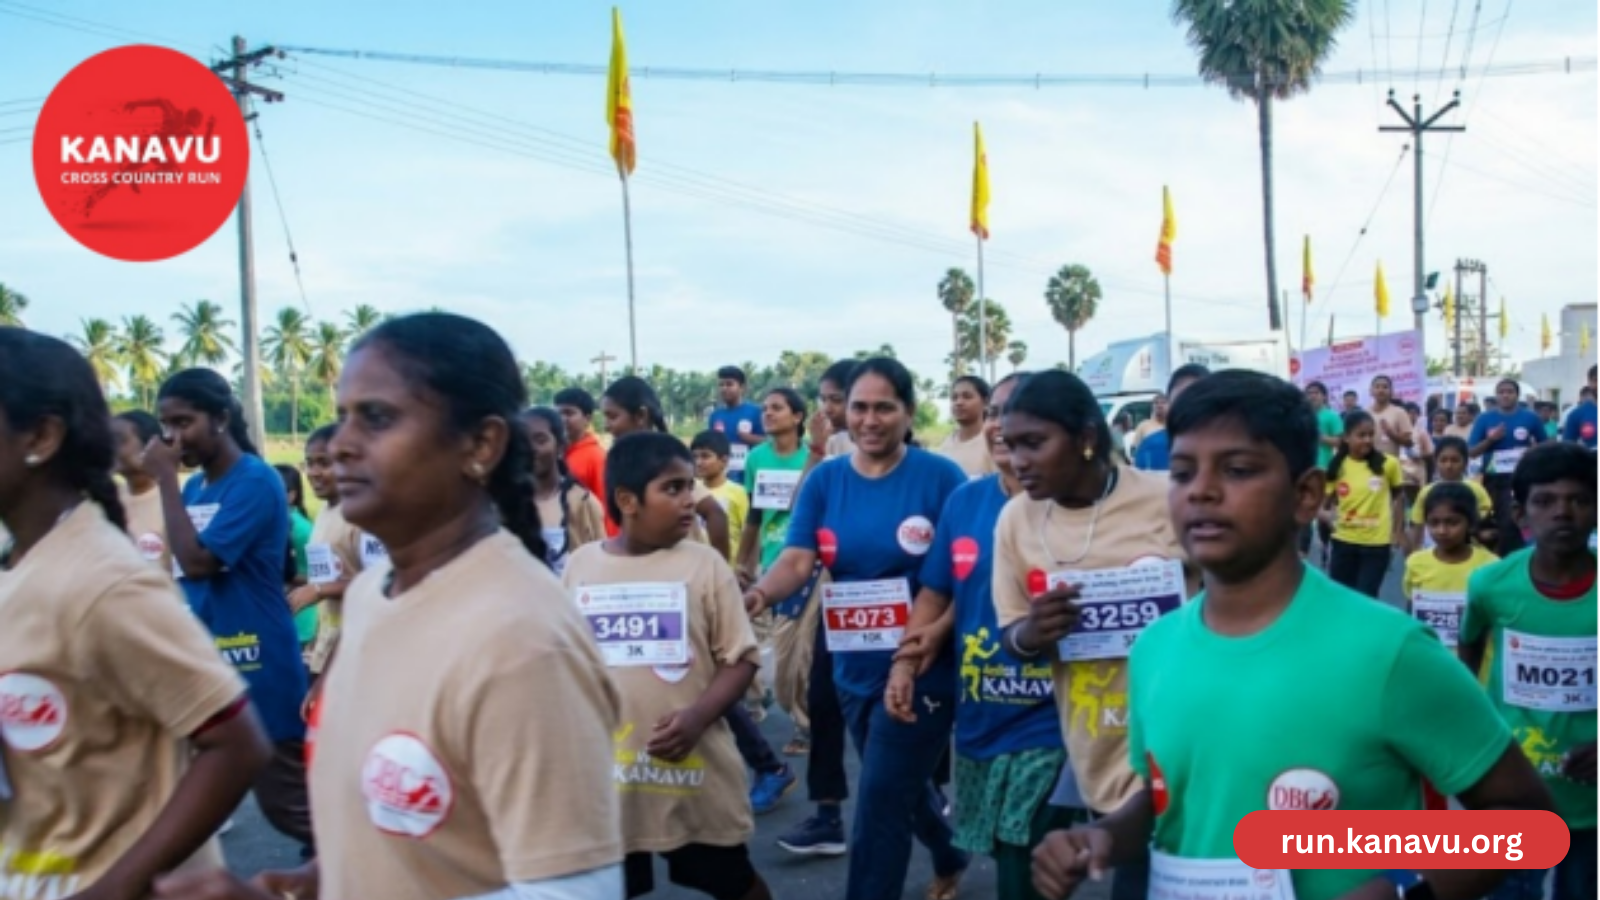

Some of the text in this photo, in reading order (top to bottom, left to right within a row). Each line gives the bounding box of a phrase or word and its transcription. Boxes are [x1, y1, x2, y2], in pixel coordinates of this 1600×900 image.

[596, 615, 659, 639] 3491
[832, 607, 896, 629] T-073
[1081, 601, 1160, 629] 3259
[626, 644, 644, 657] 3K
[982, 677, 1055, 697] KANAV
[1516, 663, 1595, 687] M021
[612, 763, 705, 787] KANAVU
